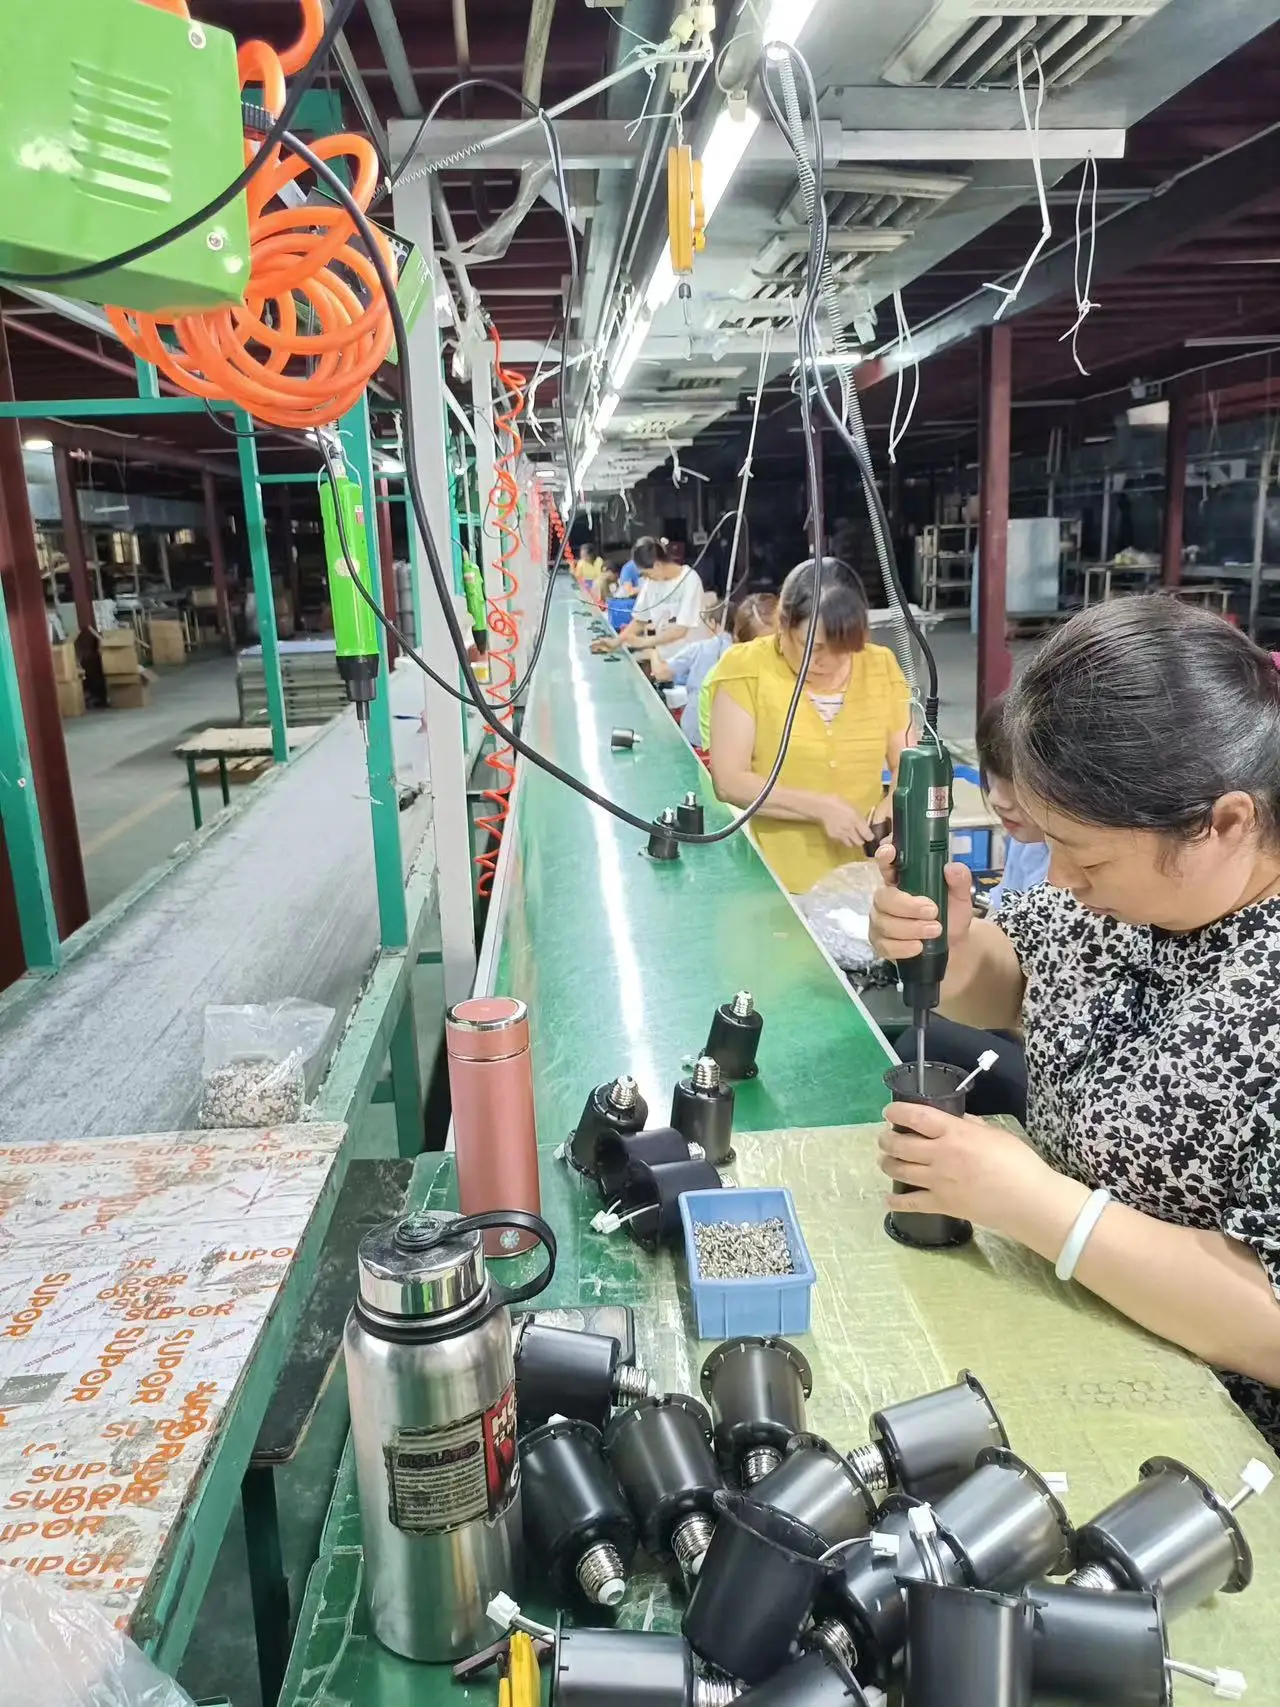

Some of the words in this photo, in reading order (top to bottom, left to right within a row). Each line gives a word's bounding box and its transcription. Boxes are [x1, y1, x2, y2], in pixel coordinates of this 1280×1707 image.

[214, 1247, 294, 1263] SUPO
[0, 1273, 71, 1336] SUPOR
[63, 1327, 145, 1402] SUPOR
[130, 1328, 195, 1404] SUPOR
